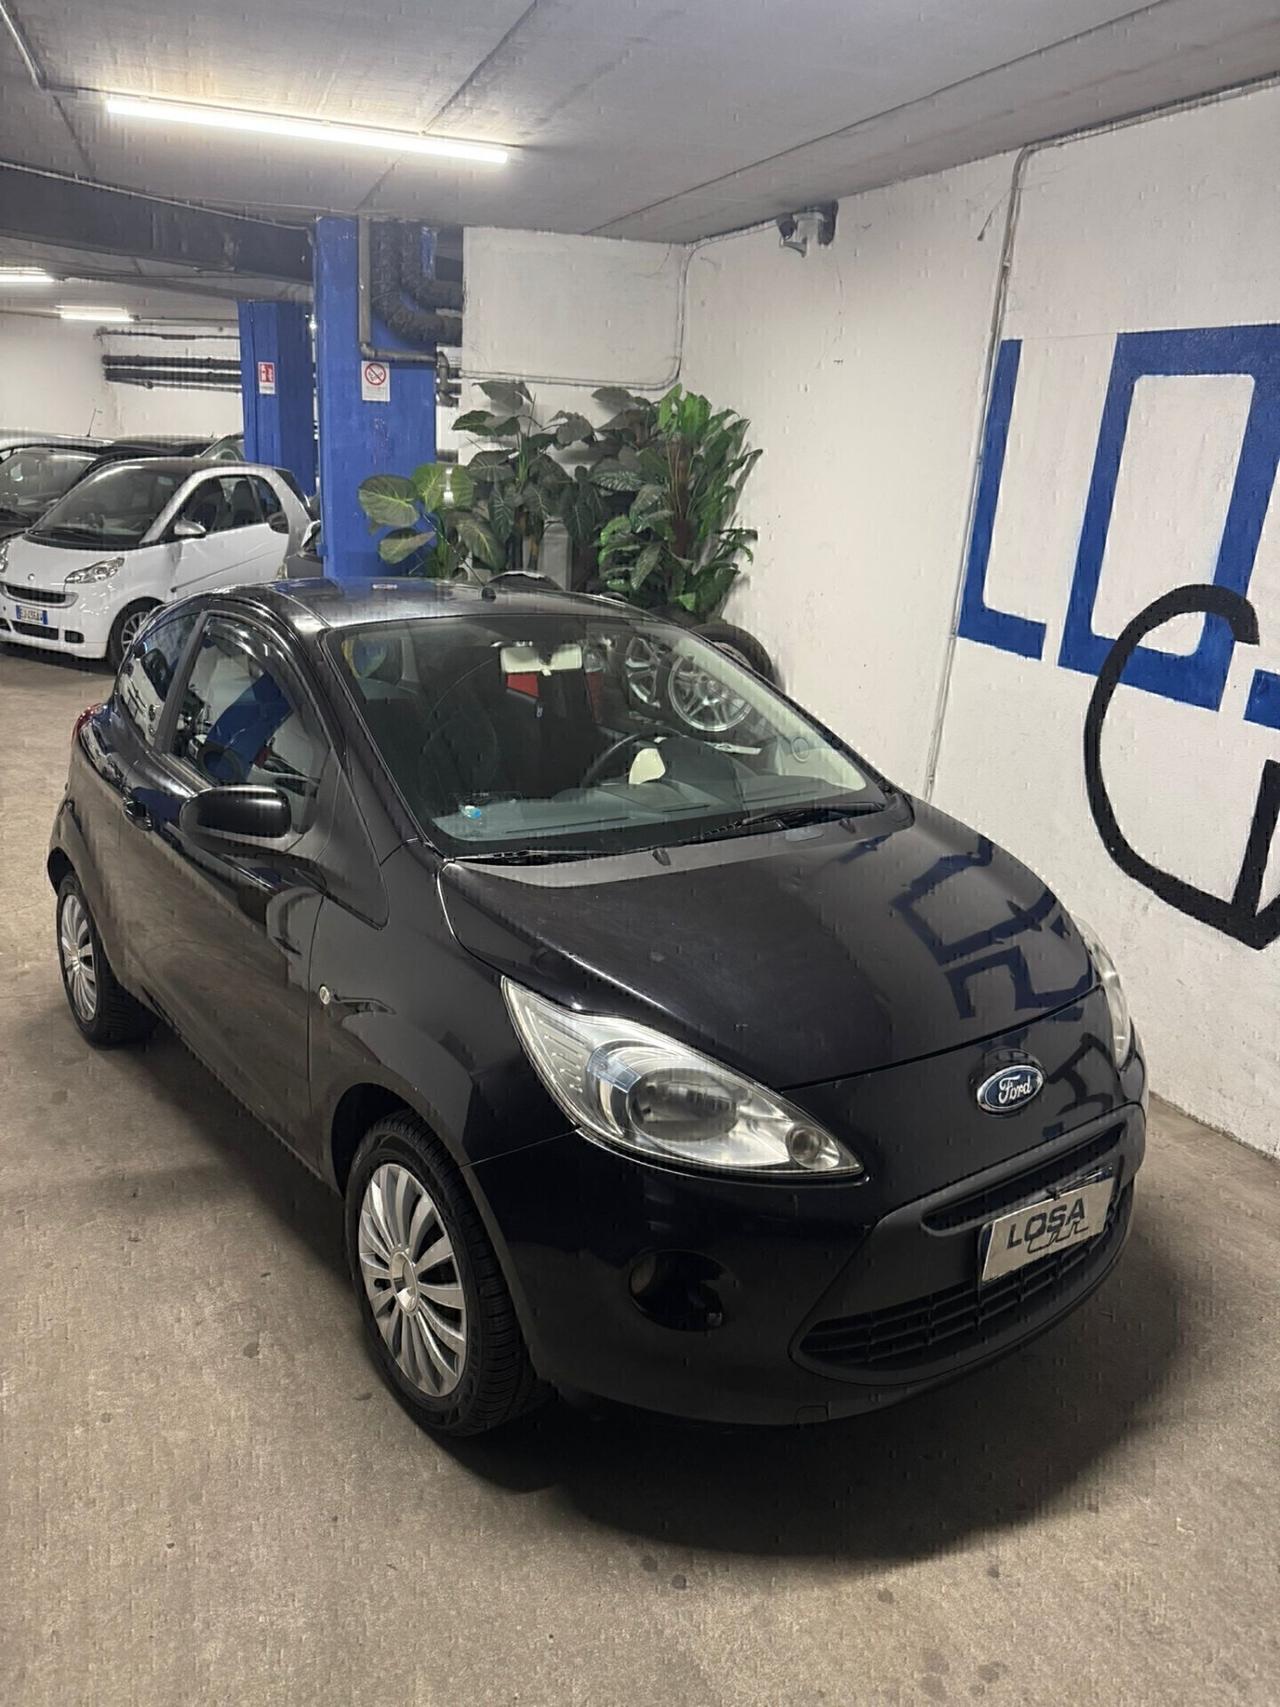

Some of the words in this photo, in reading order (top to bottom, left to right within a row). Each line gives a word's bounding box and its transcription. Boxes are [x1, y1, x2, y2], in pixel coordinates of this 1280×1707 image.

[957, 323, 1280, 731] LO
[998, 1074, 1032, 1104] Ford
[1007, 1197, 1086, 1249] LOSA
